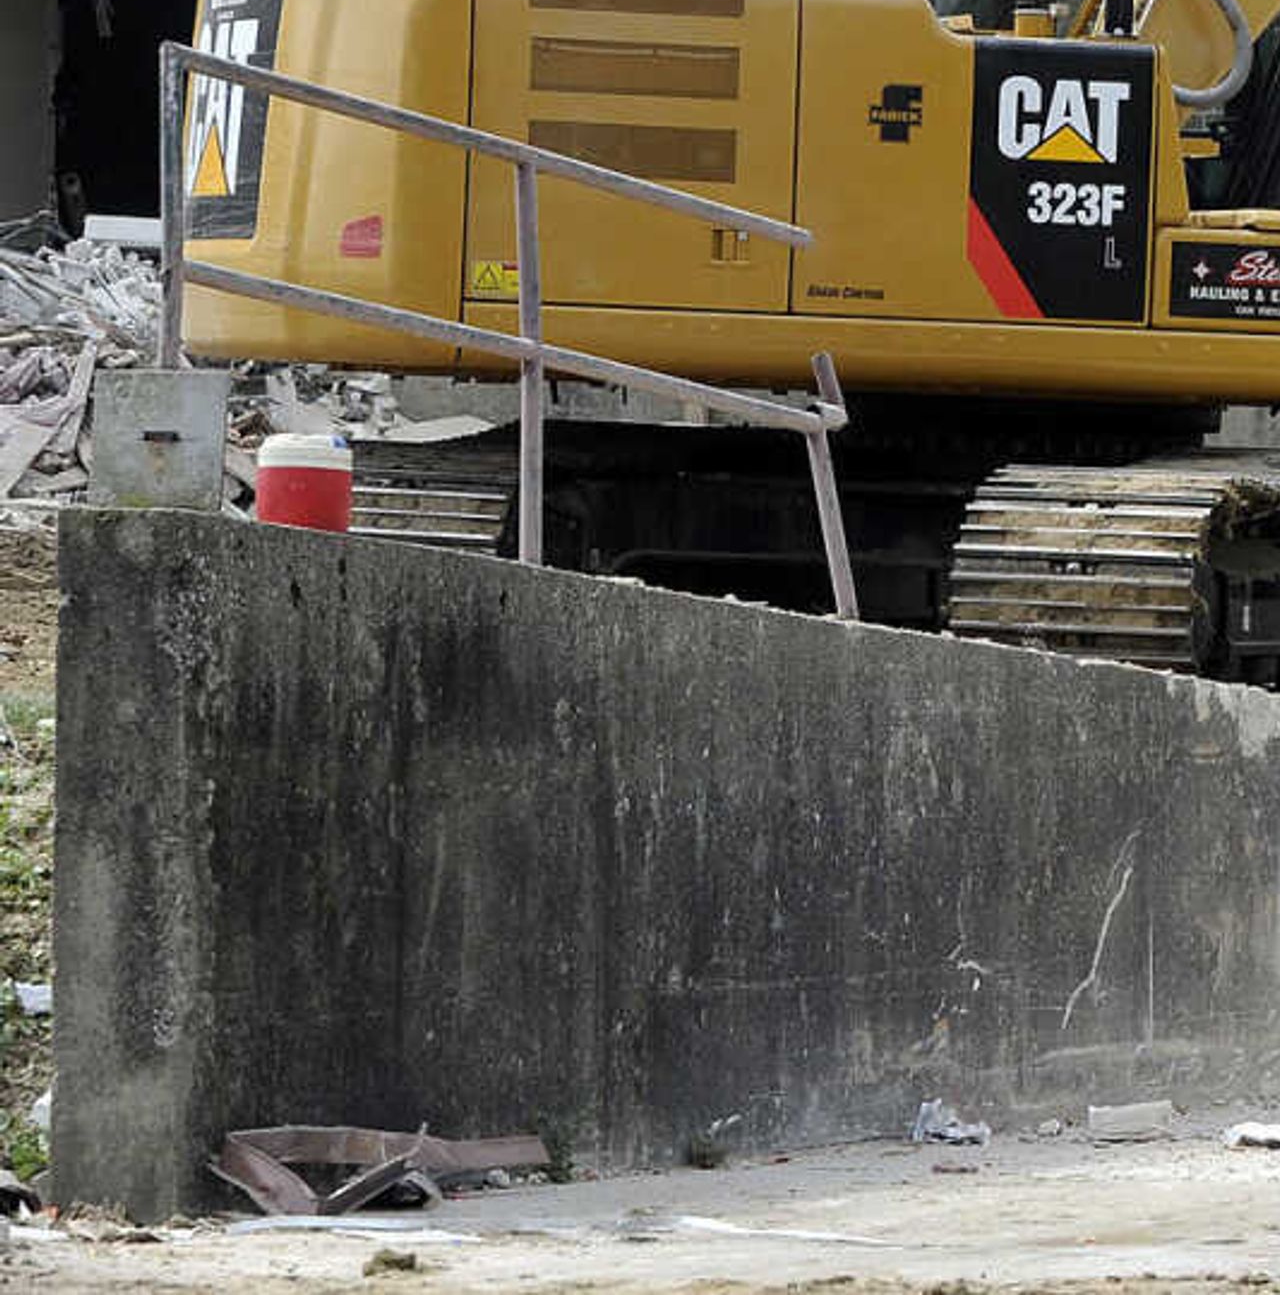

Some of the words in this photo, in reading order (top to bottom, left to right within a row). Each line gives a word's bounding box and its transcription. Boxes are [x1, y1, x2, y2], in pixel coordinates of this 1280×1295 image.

[998, 75, 1130, 163] CAT
[1027, 181, 1126, 227] 323F
[1104, 236, 1123, 269] L
[1189, 285, 1250, 301] HAULING
